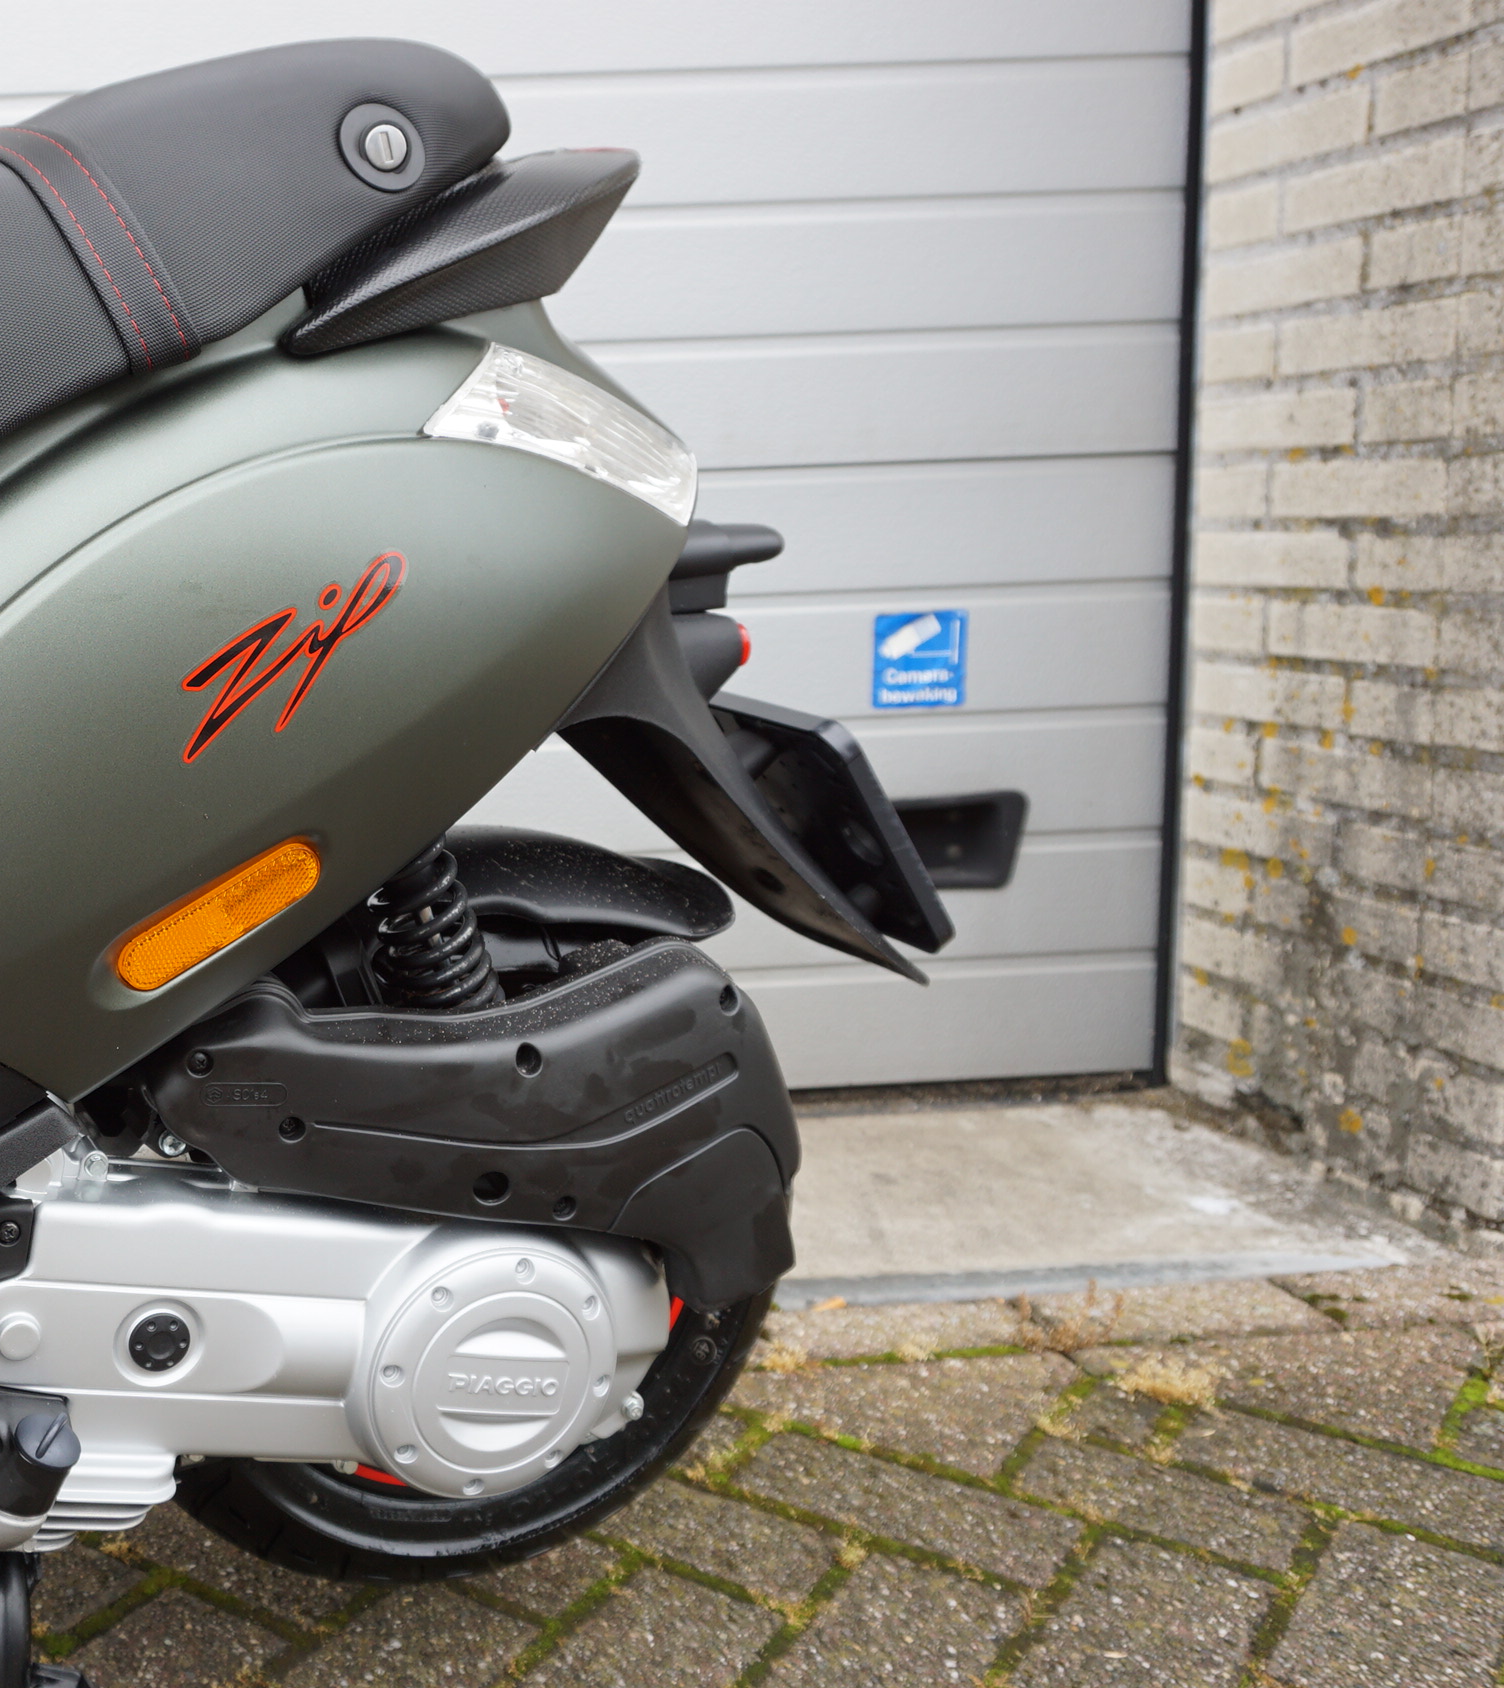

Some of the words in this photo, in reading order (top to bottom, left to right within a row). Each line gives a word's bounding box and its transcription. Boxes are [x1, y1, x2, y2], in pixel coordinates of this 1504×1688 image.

[181, 551, 407, 764] Zip
[878, 687, 958, 704] bewaking
[447, 1371, 560, 1397] PIAGGIO
